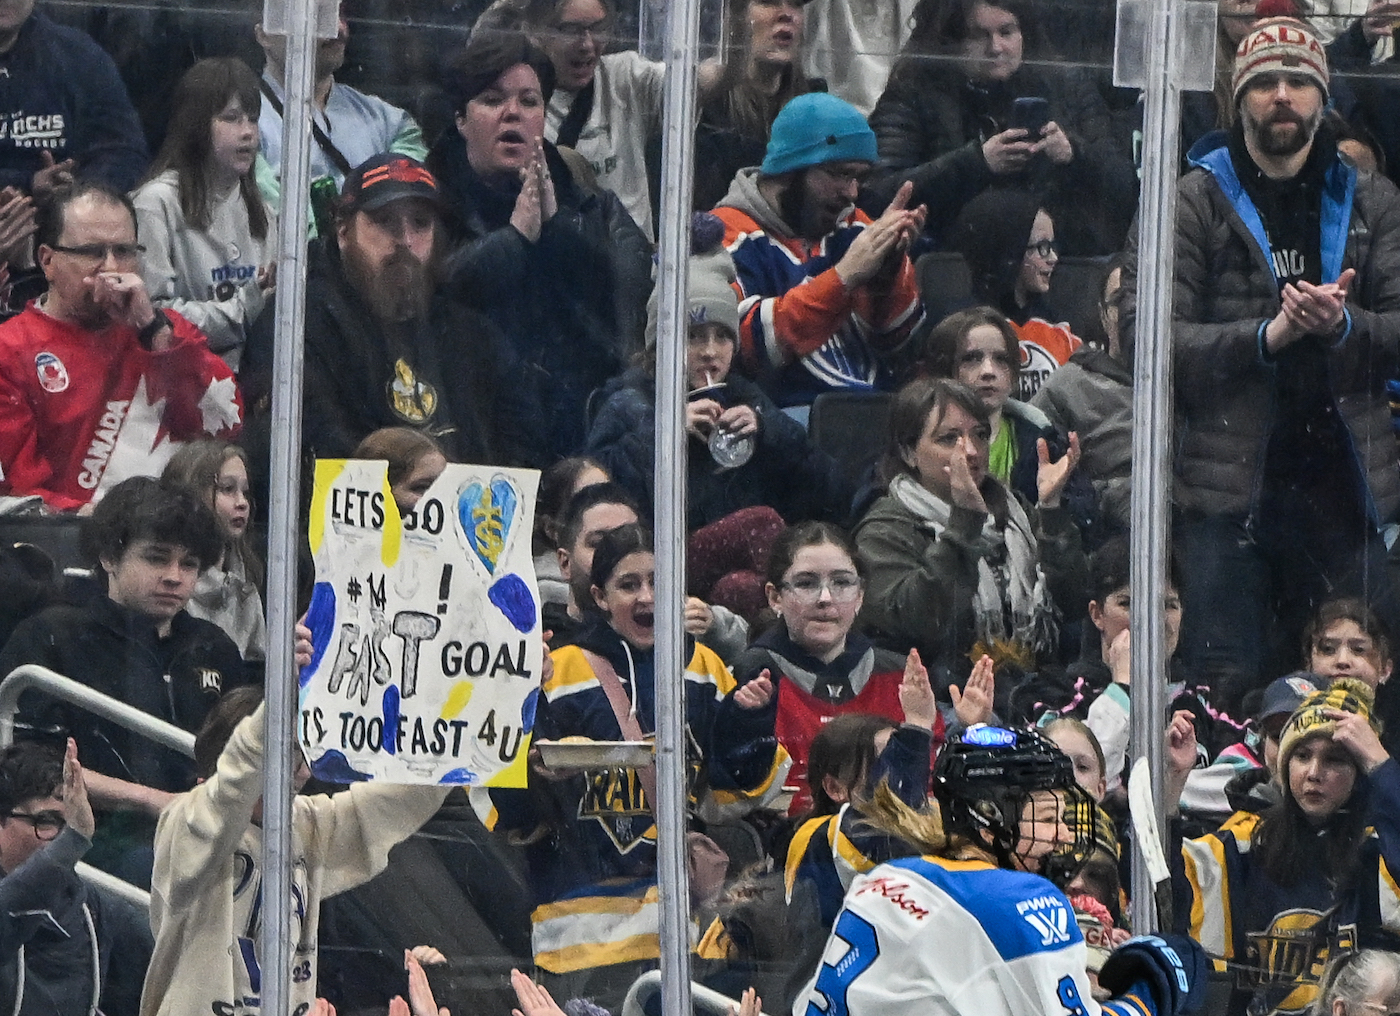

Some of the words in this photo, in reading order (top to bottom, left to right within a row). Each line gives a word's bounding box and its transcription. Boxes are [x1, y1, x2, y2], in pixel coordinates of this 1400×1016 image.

[77, 400, 130, 489] CANADA
[332, 488, 385, 530] LETS
[441, 639, 532, 679] GOAL
[339, 711, 384, 752] TOO
[397, 716, 468, 757] FAST
[1016, 896, 1064, 916] PWHL
